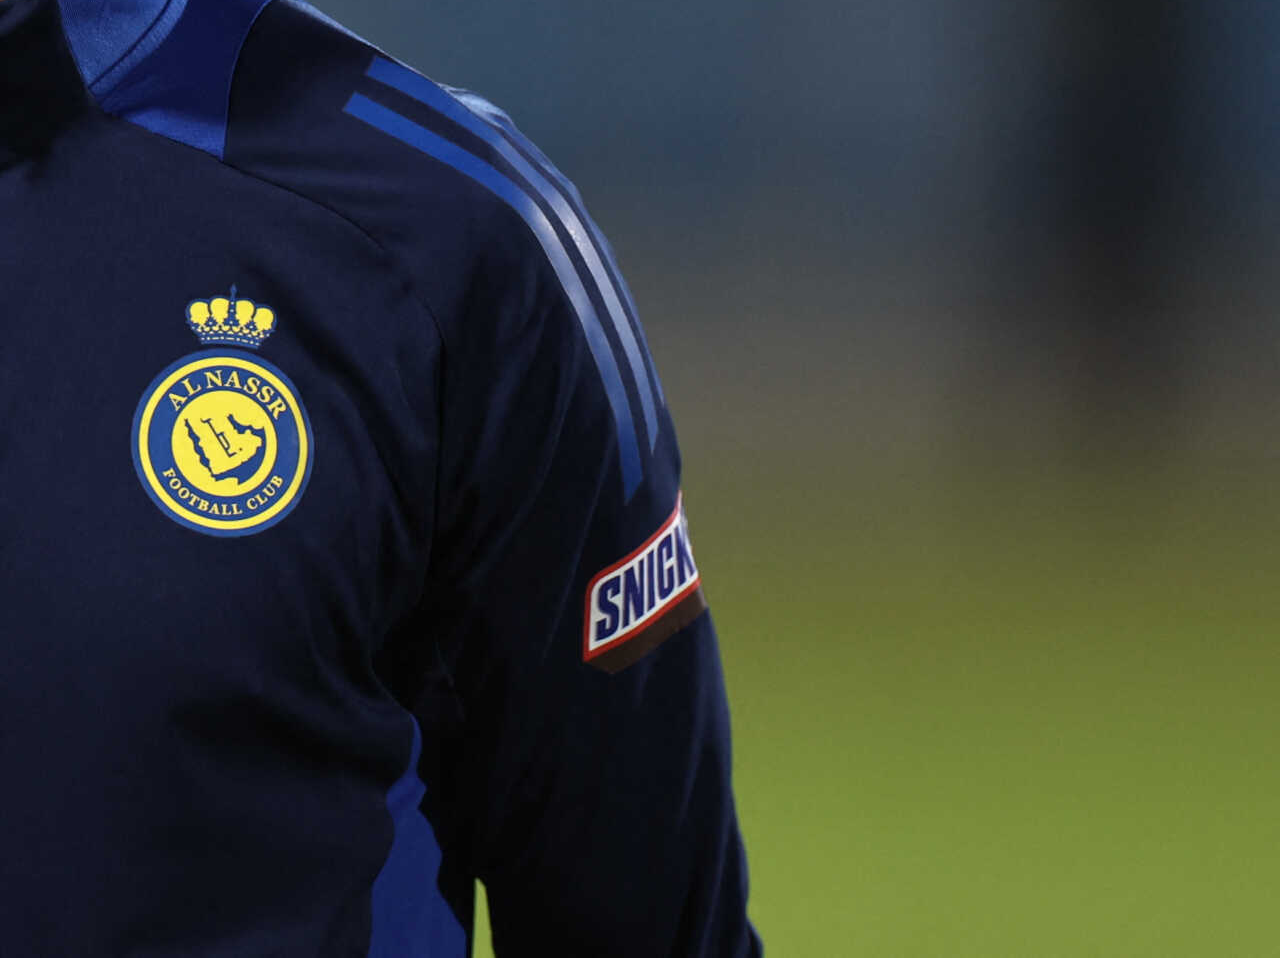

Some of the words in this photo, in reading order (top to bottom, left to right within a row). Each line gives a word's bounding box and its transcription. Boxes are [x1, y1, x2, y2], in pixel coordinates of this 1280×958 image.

[168, 378, 202, 411] AL
[204, 370, 287, 420] NASSR
[162, 468, 243, 515] FOOTBALL
[246, 475, 283, 510] CLUB
